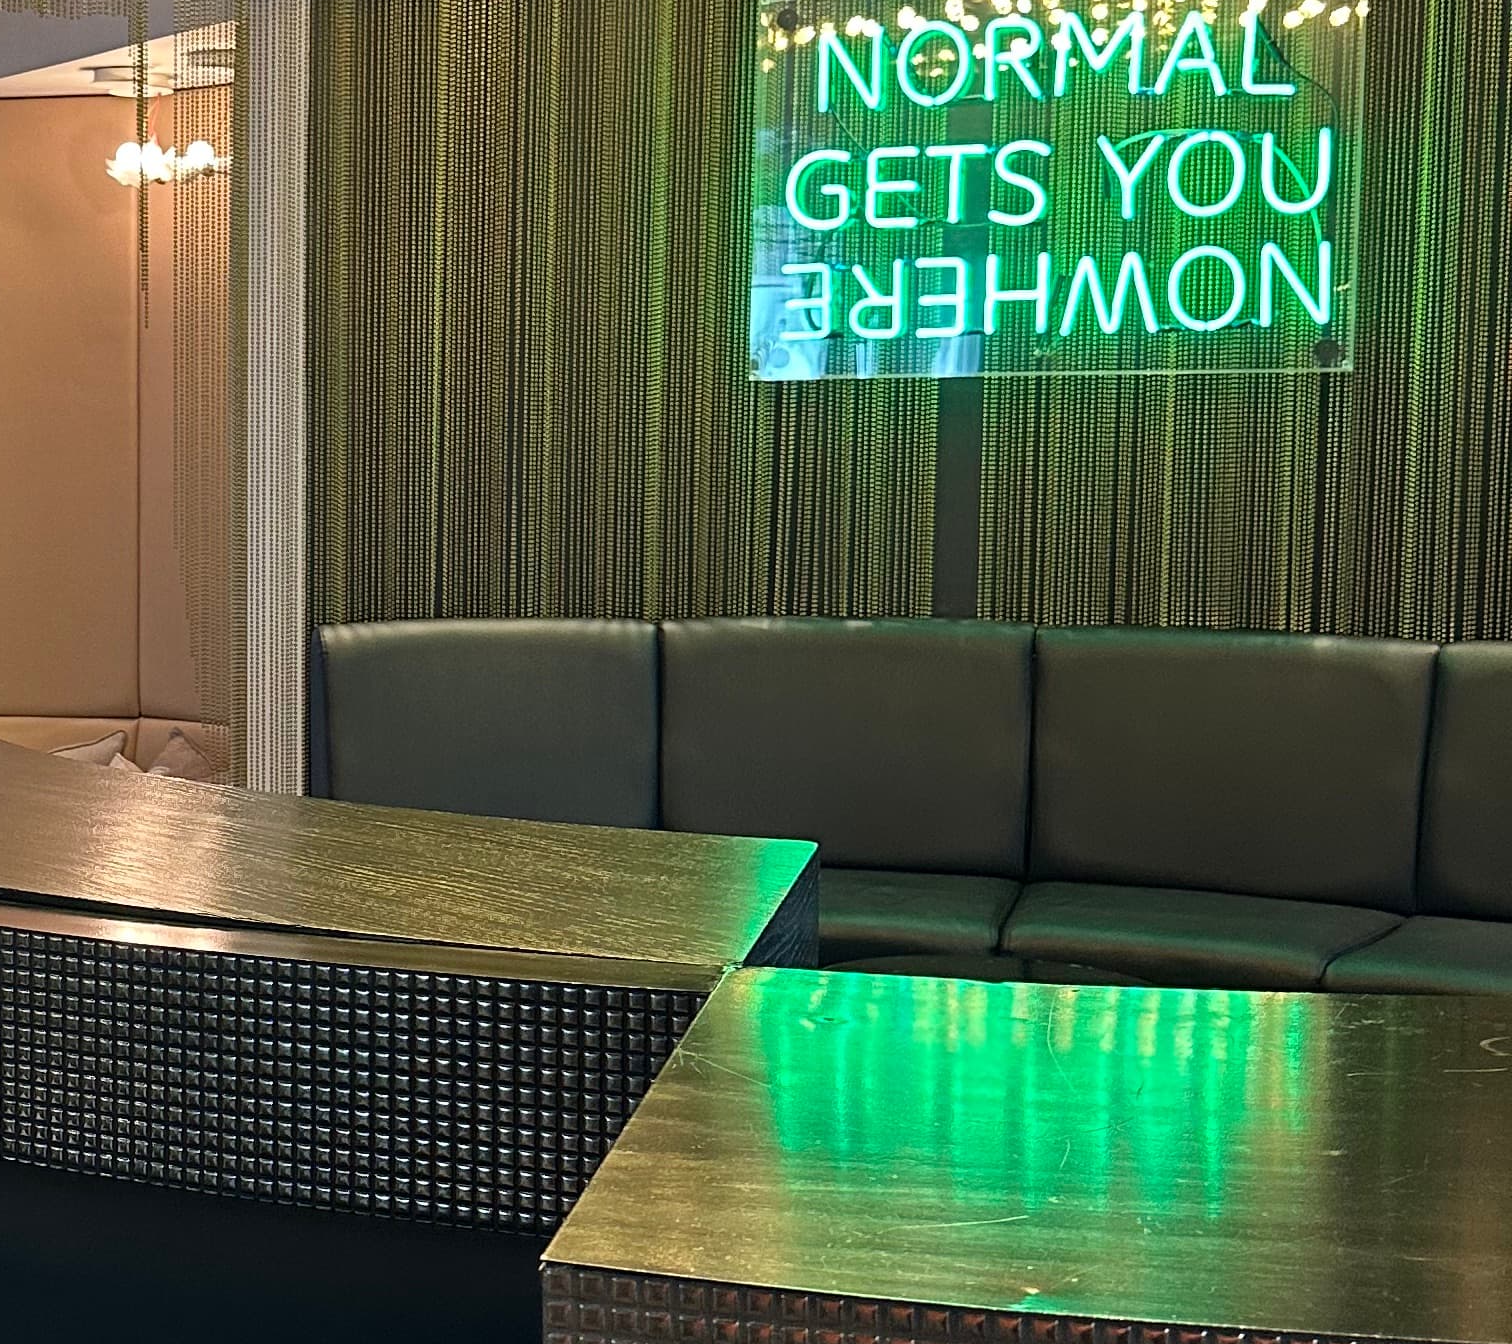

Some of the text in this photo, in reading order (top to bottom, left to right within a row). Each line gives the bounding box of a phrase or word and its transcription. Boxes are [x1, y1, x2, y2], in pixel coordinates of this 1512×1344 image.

[817, 10, 1297, 113] NORMAL
[785, 127, 1332, 231] GETS YOU
[780, 240, 1332, 340] NOWHERE
